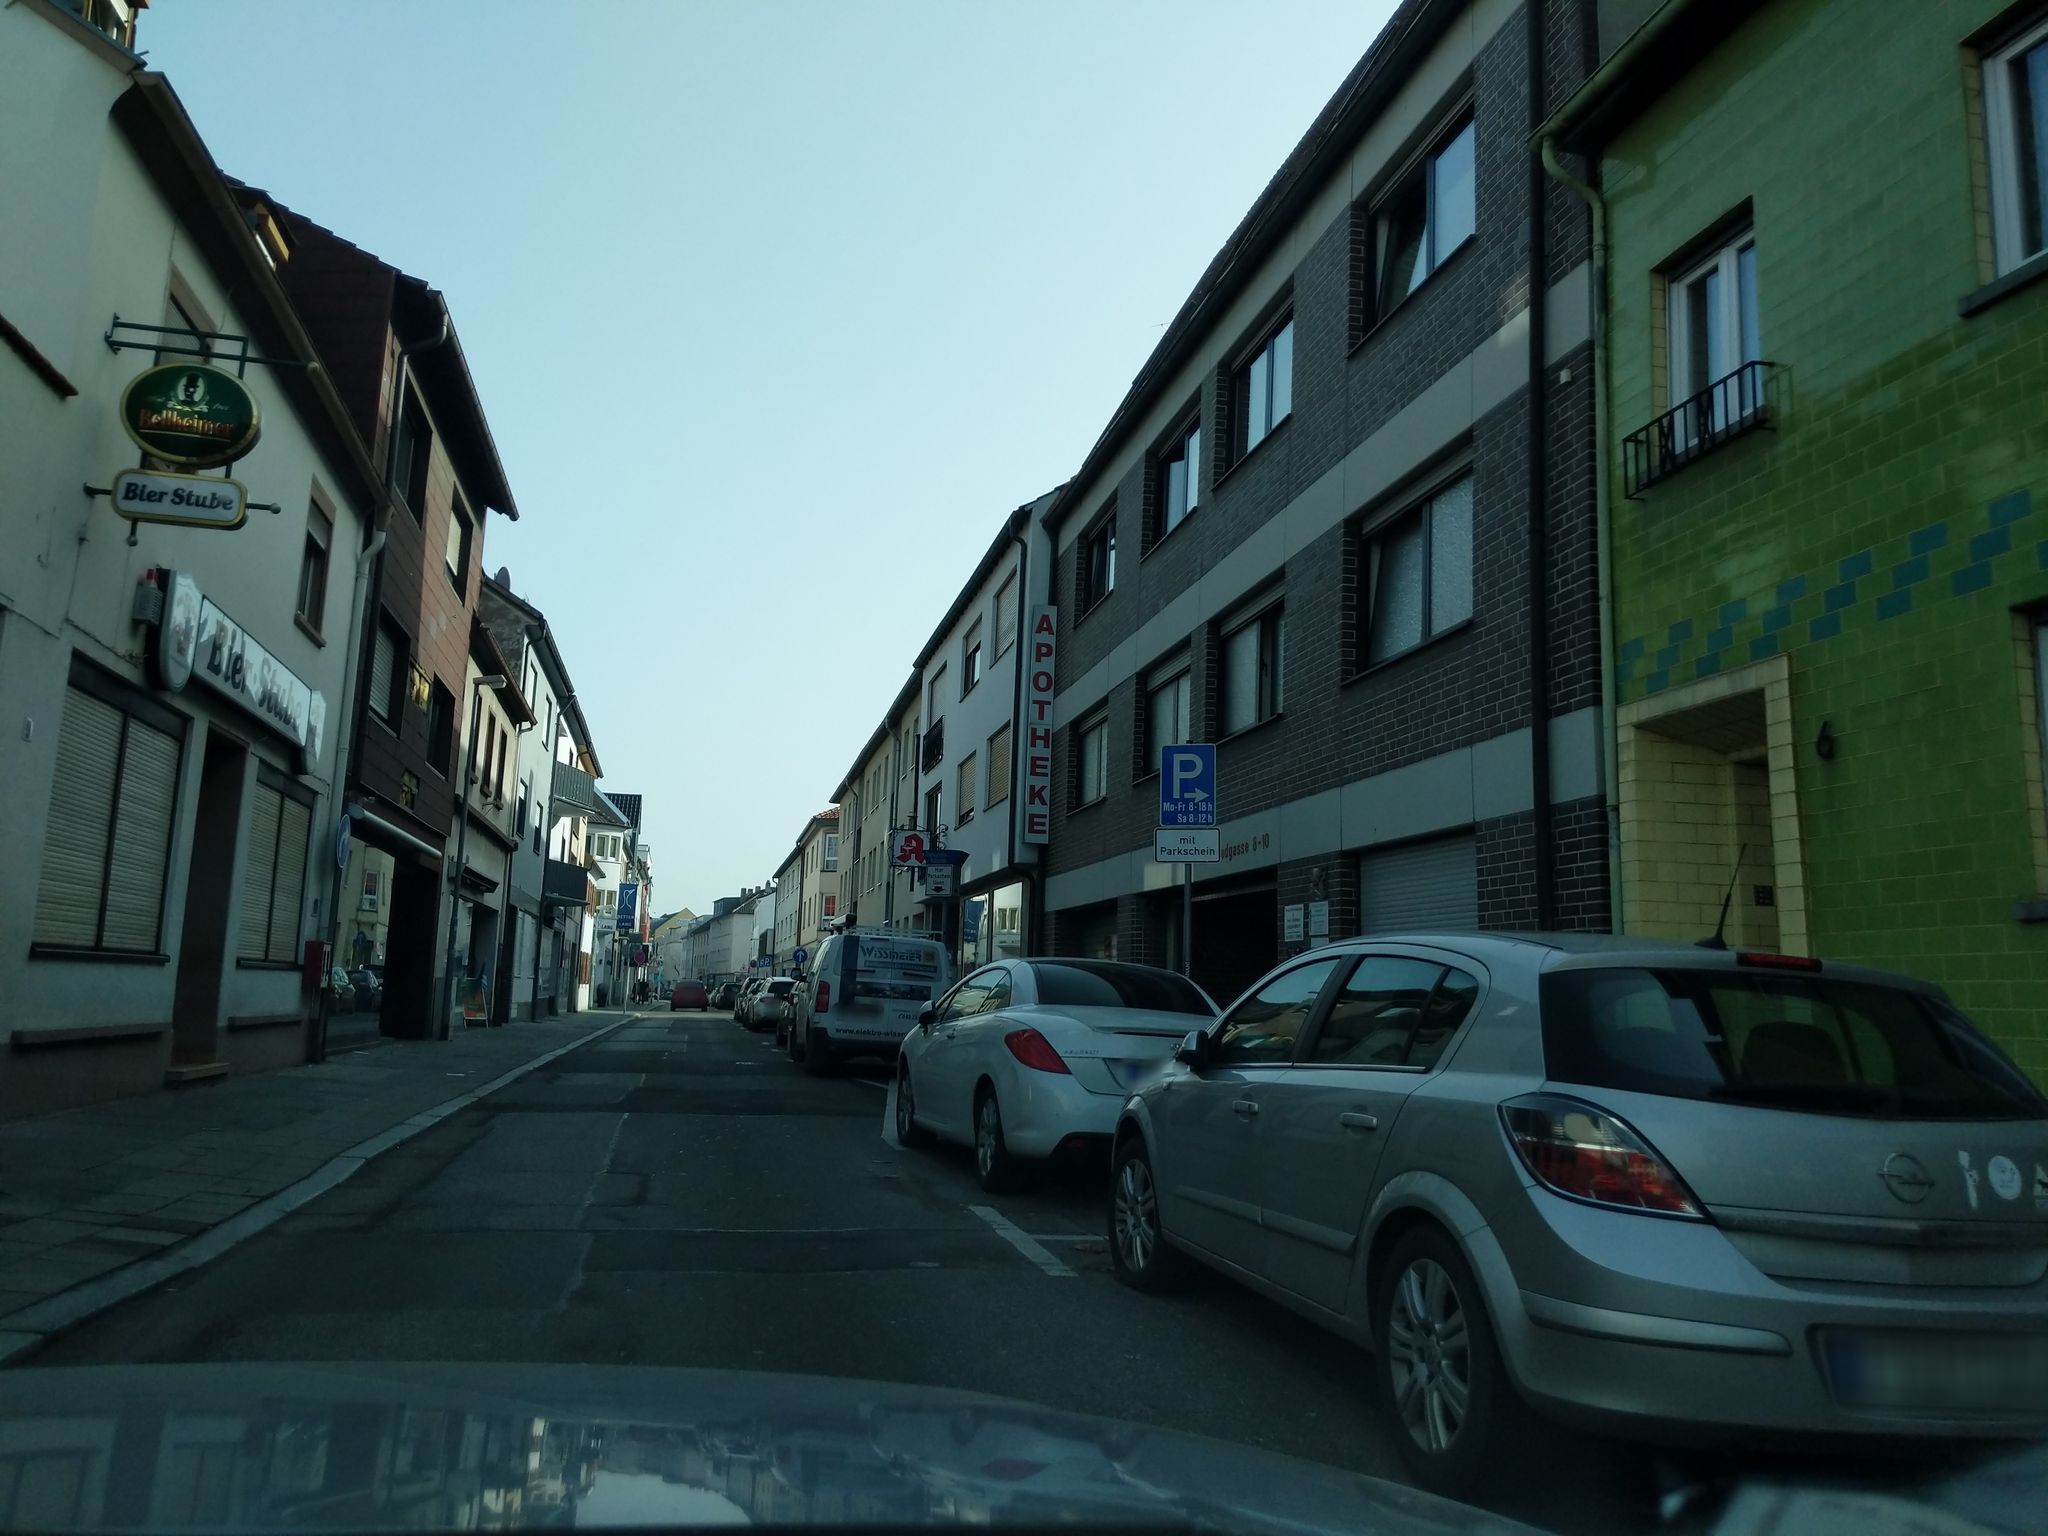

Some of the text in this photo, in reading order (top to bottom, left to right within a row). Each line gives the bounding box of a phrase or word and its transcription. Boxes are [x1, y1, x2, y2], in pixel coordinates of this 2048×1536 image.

[122, 482, 234, 511] Bier Stube
[1027, 613, 1055, 835] APOTHEKE
[1172, 752, 1204, 799] P
[1163, 801, 1186, 812] Mo-Fr
[1177, 813, 1187, 823] Sa
[1179, 835, 1195, 845] mit
[1252, 833, 1270, 851] 8-10
[1160, 846, 1216, 856] Parkschein
